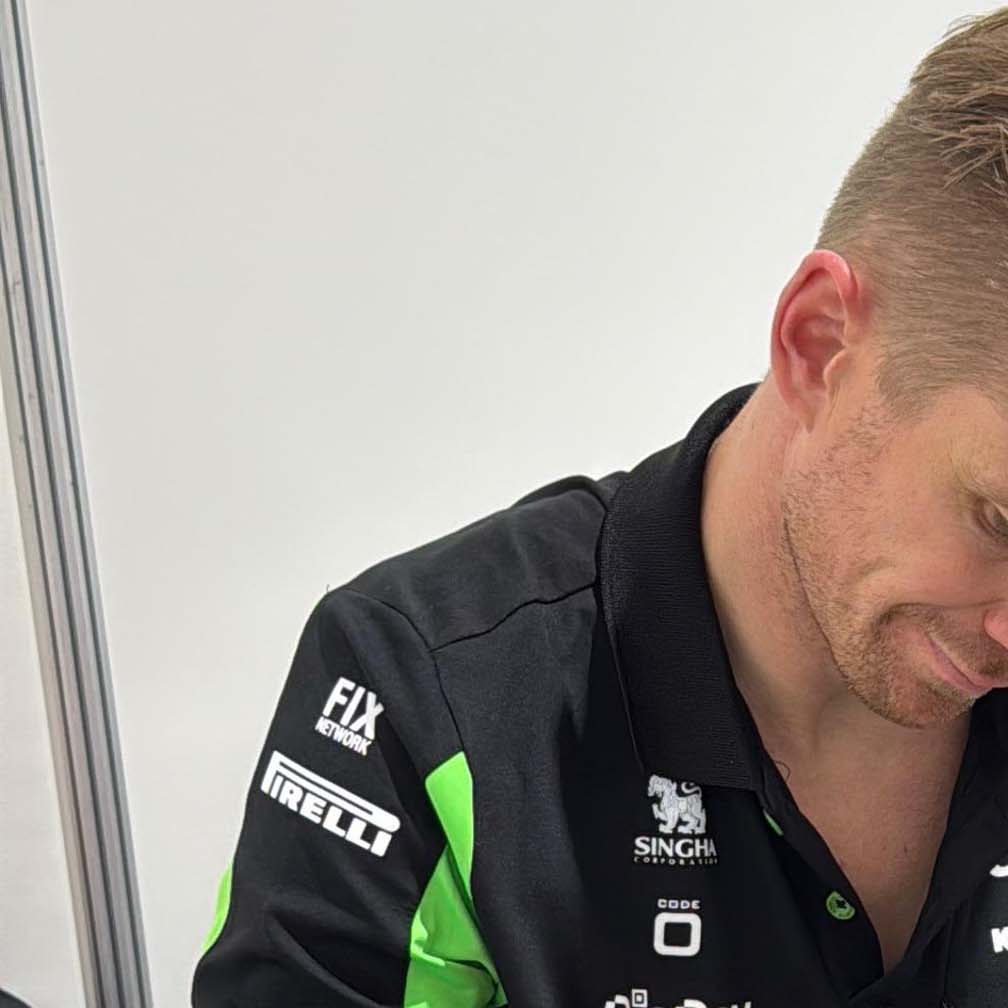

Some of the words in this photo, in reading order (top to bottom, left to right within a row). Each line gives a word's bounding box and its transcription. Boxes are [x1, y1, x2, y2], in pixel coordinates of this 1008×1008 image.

[322, 676, 384, 740] FIX
[315, 716, 373, 757] NETWORK
[260, 750, 401, 857] PIRELLI
[633, 836, 717, 859] SINGHA
[657, 898, 701, 911] CODE
